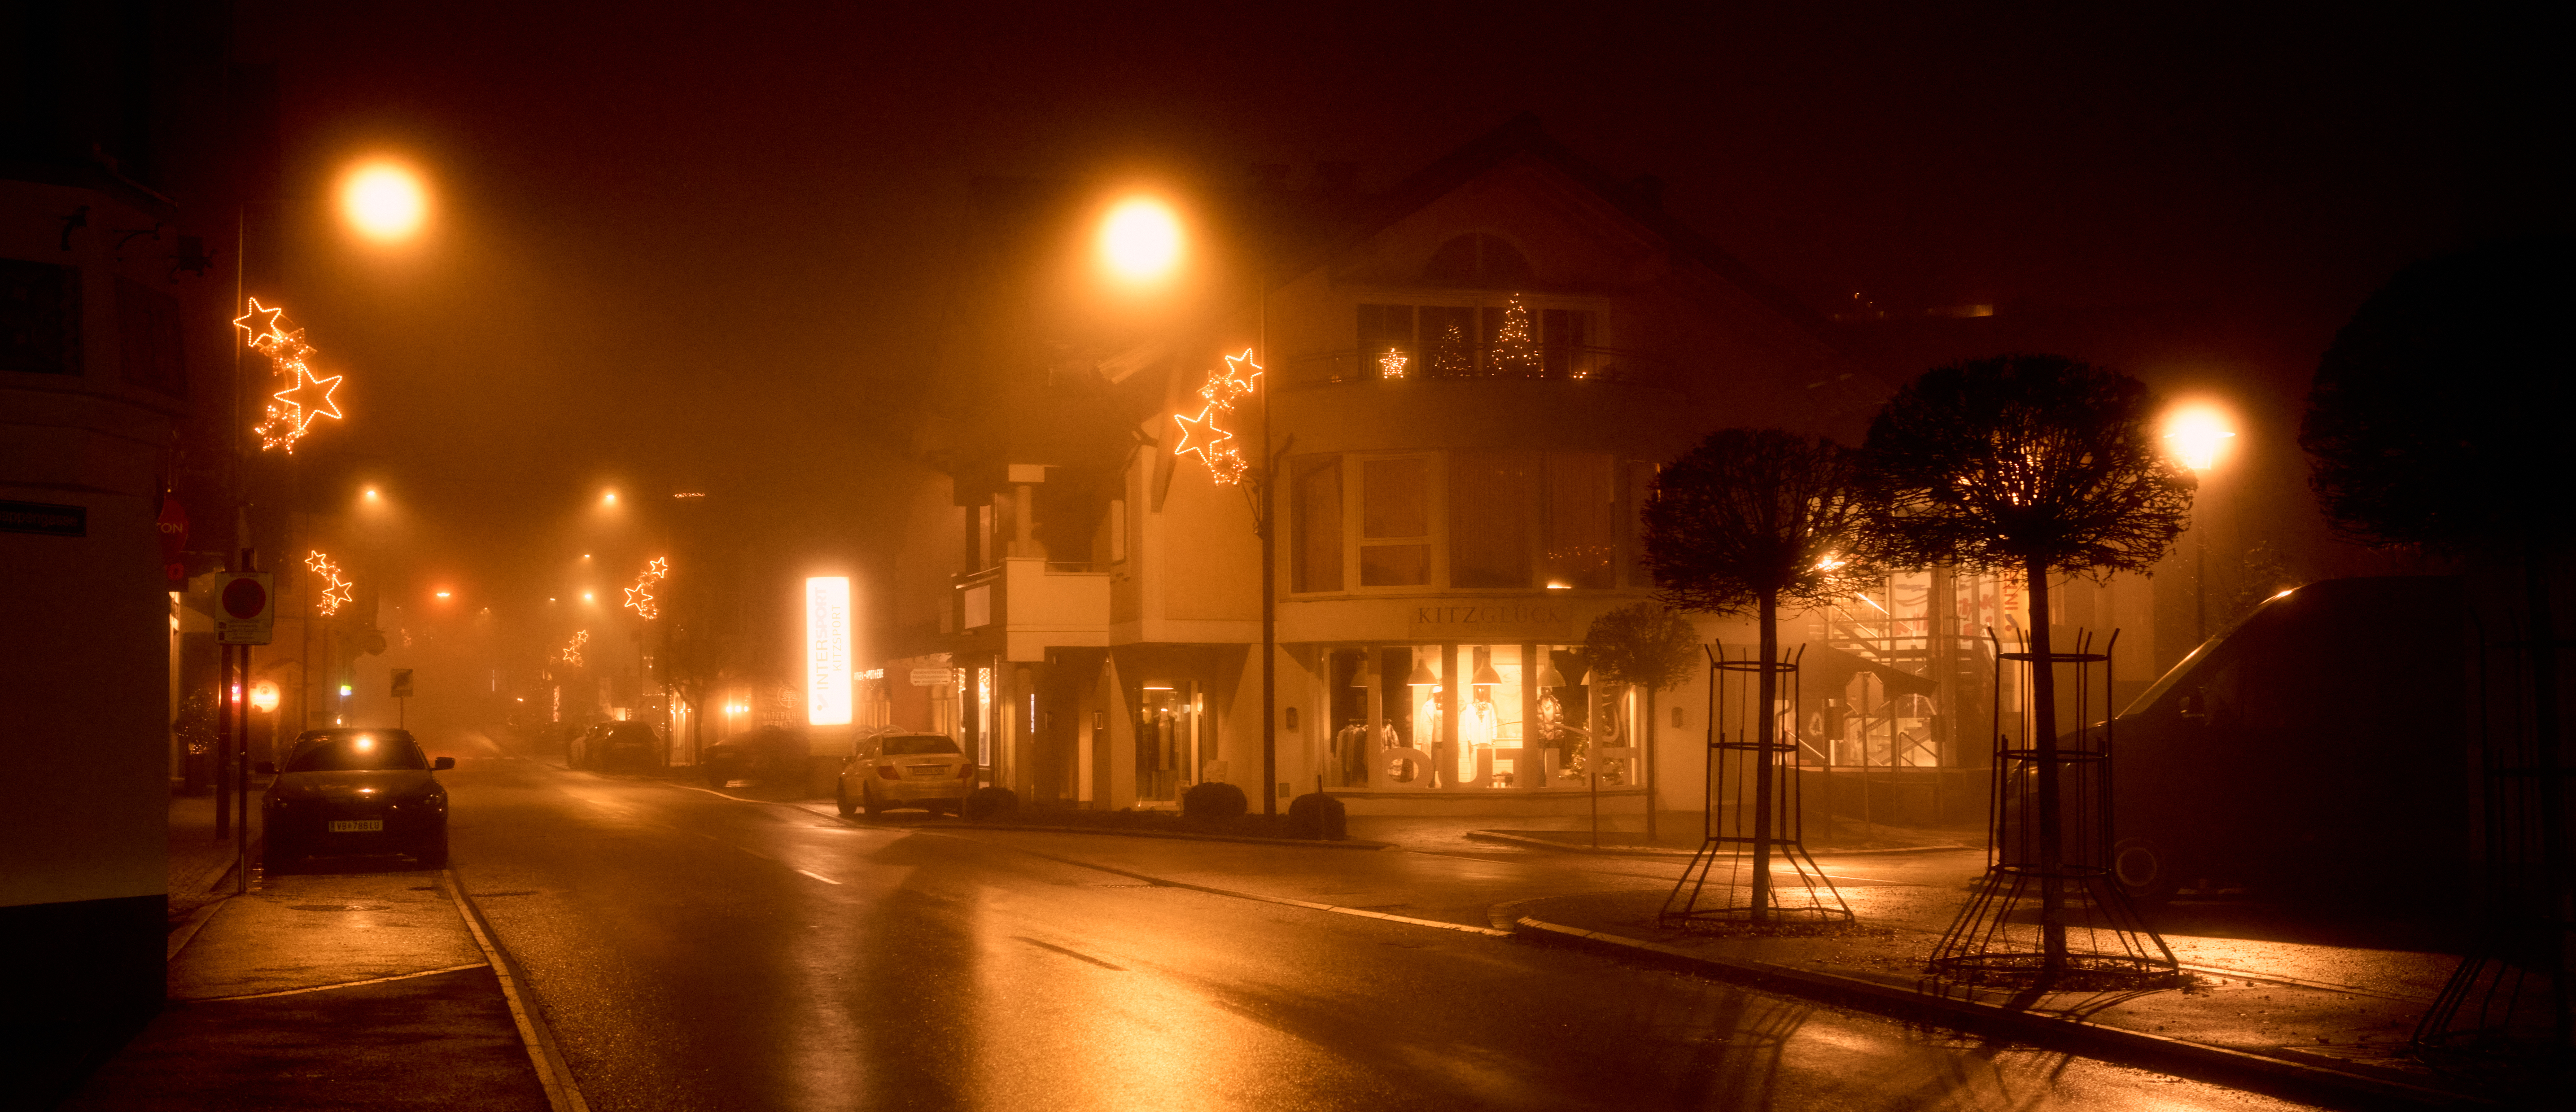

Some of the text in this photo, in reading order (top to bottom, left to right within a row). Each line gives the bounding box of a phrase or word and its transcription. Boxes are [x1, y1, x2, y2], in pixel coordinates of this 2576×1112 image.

[0, 511, 78, 528] appengasse
[1418, 603, 1562, 624] KITZGLÜCK
[814, 587, 829, 690] INTERSPORT
[831, 604, 842, 671] KITZSPORT
